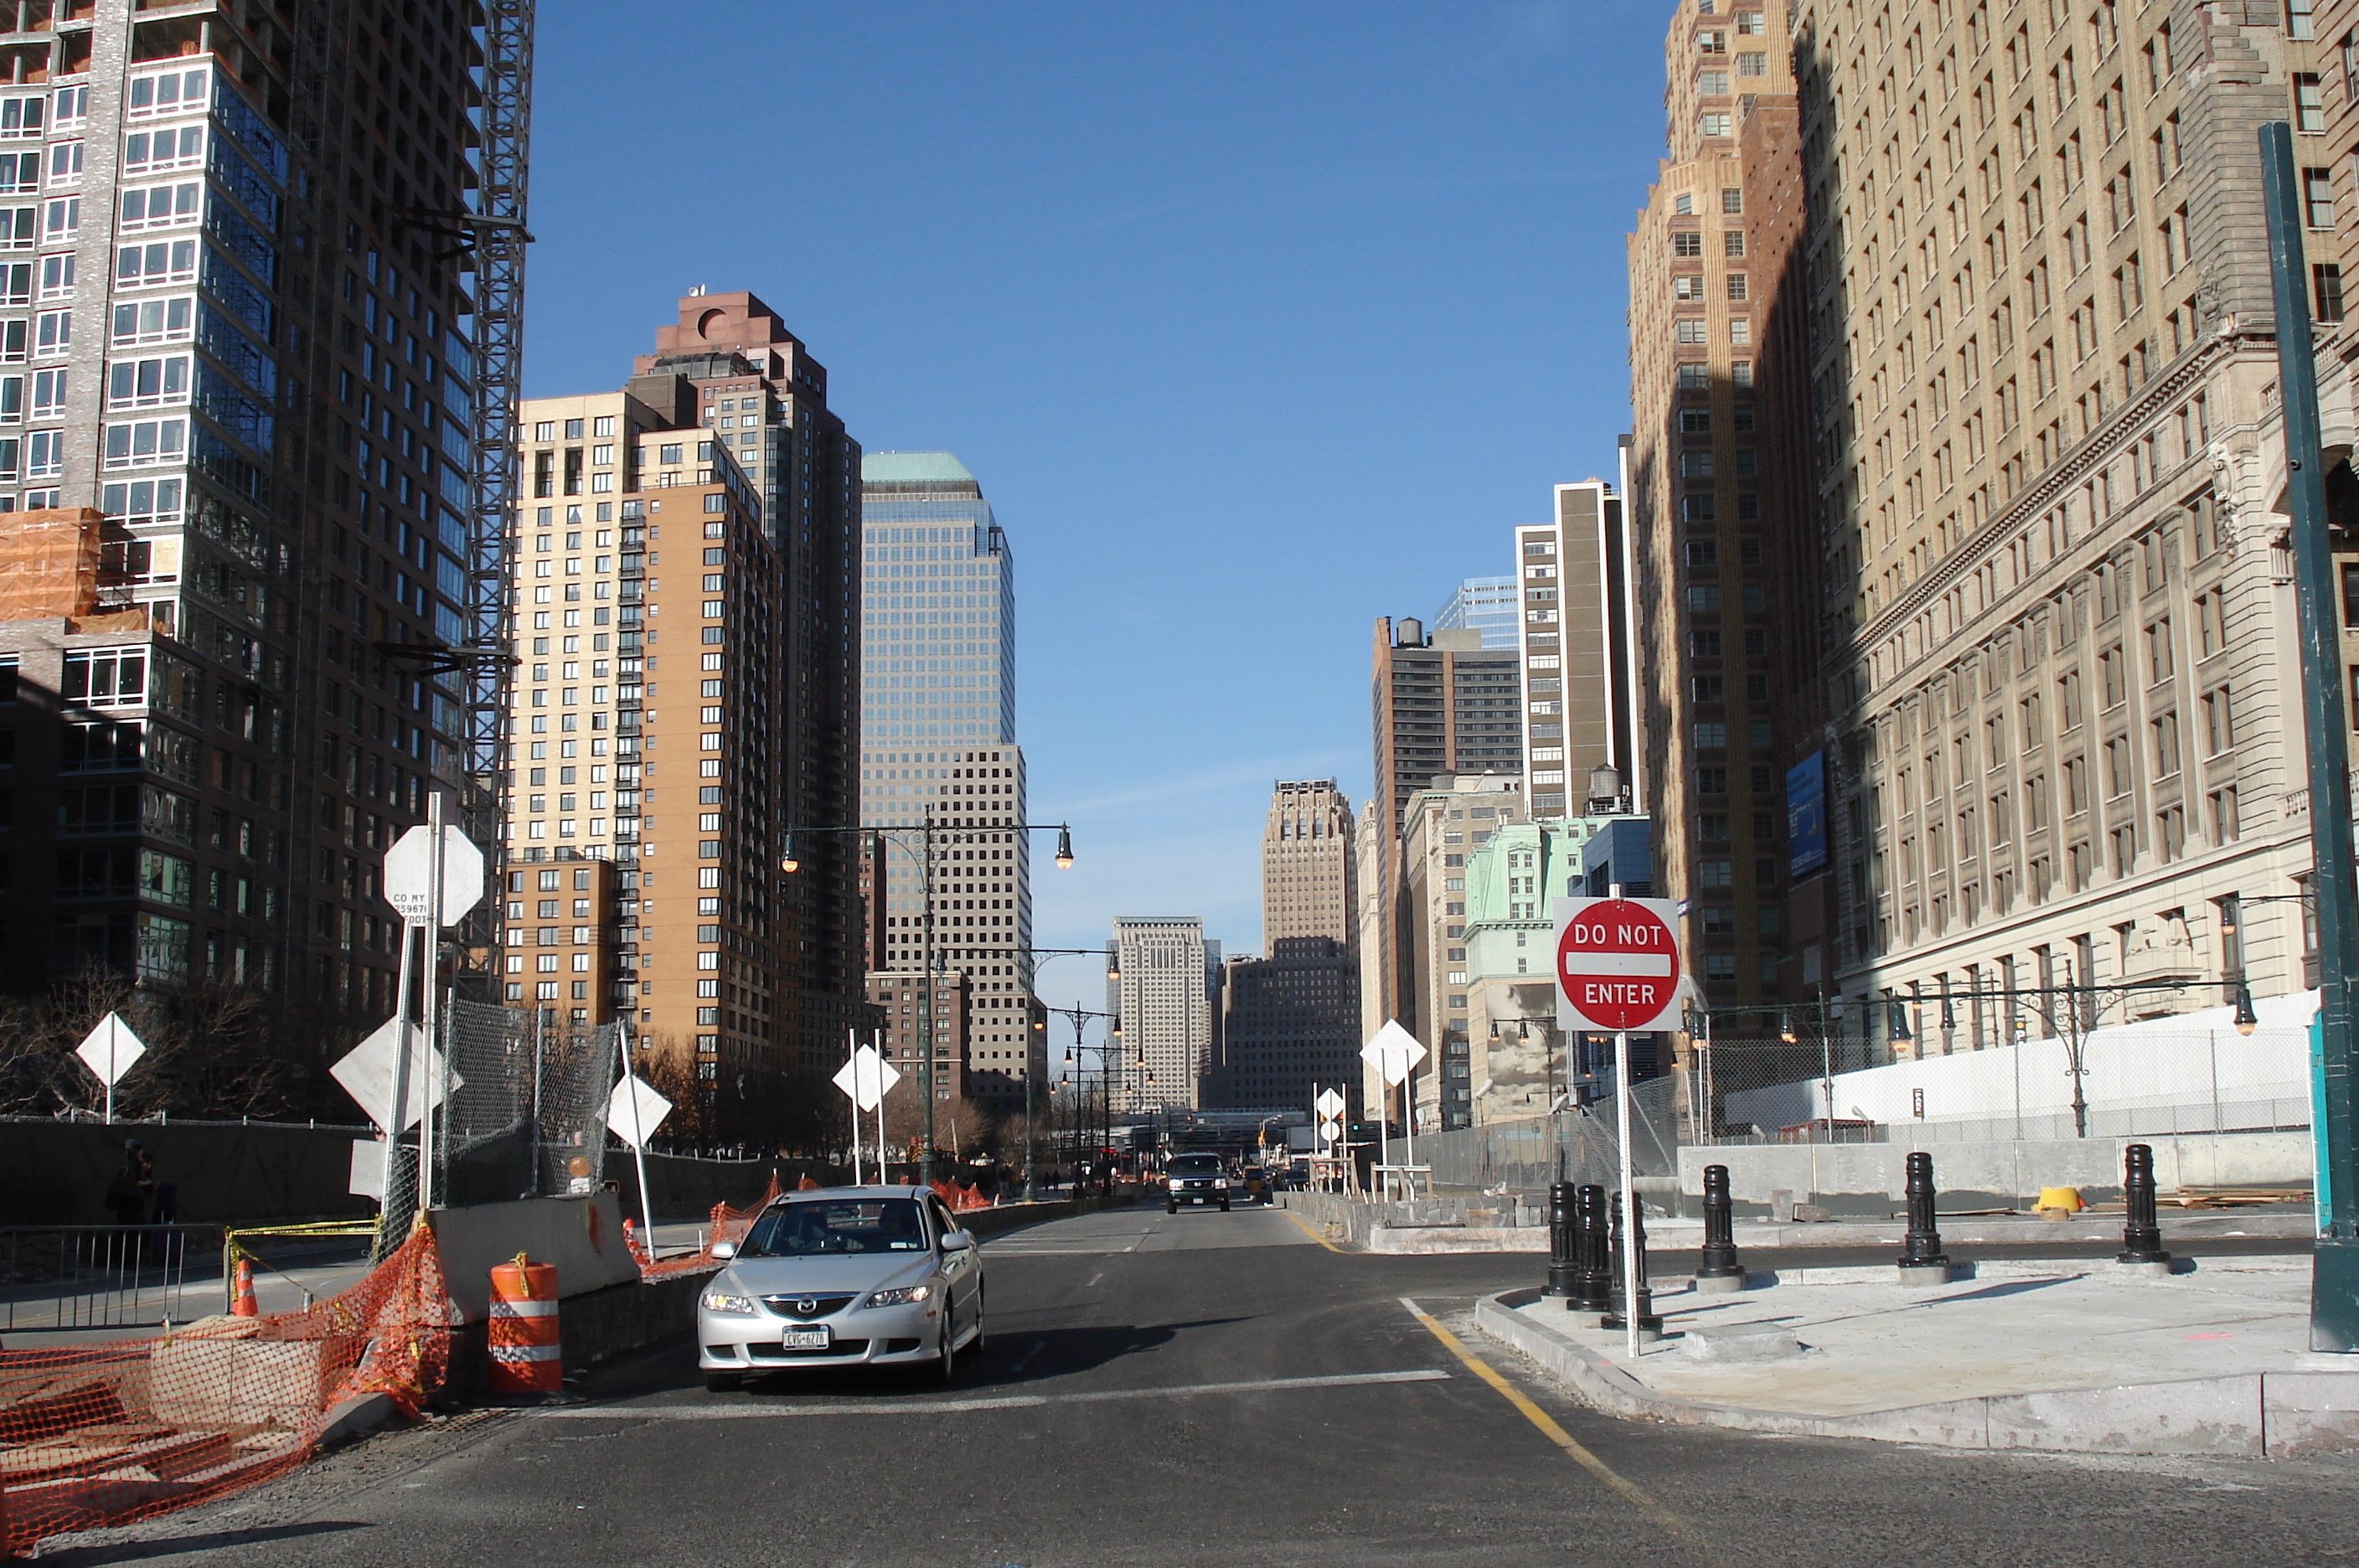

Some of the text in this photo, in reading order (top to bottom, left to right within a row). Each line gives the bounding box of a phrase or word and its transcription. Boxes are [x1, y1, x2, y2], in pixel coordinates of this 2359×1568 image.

[394, 894, 407, 902] CO
[1574, 924, 1661, 946] DO NOT
[1585, 983, 1654, 1004] ENTER
